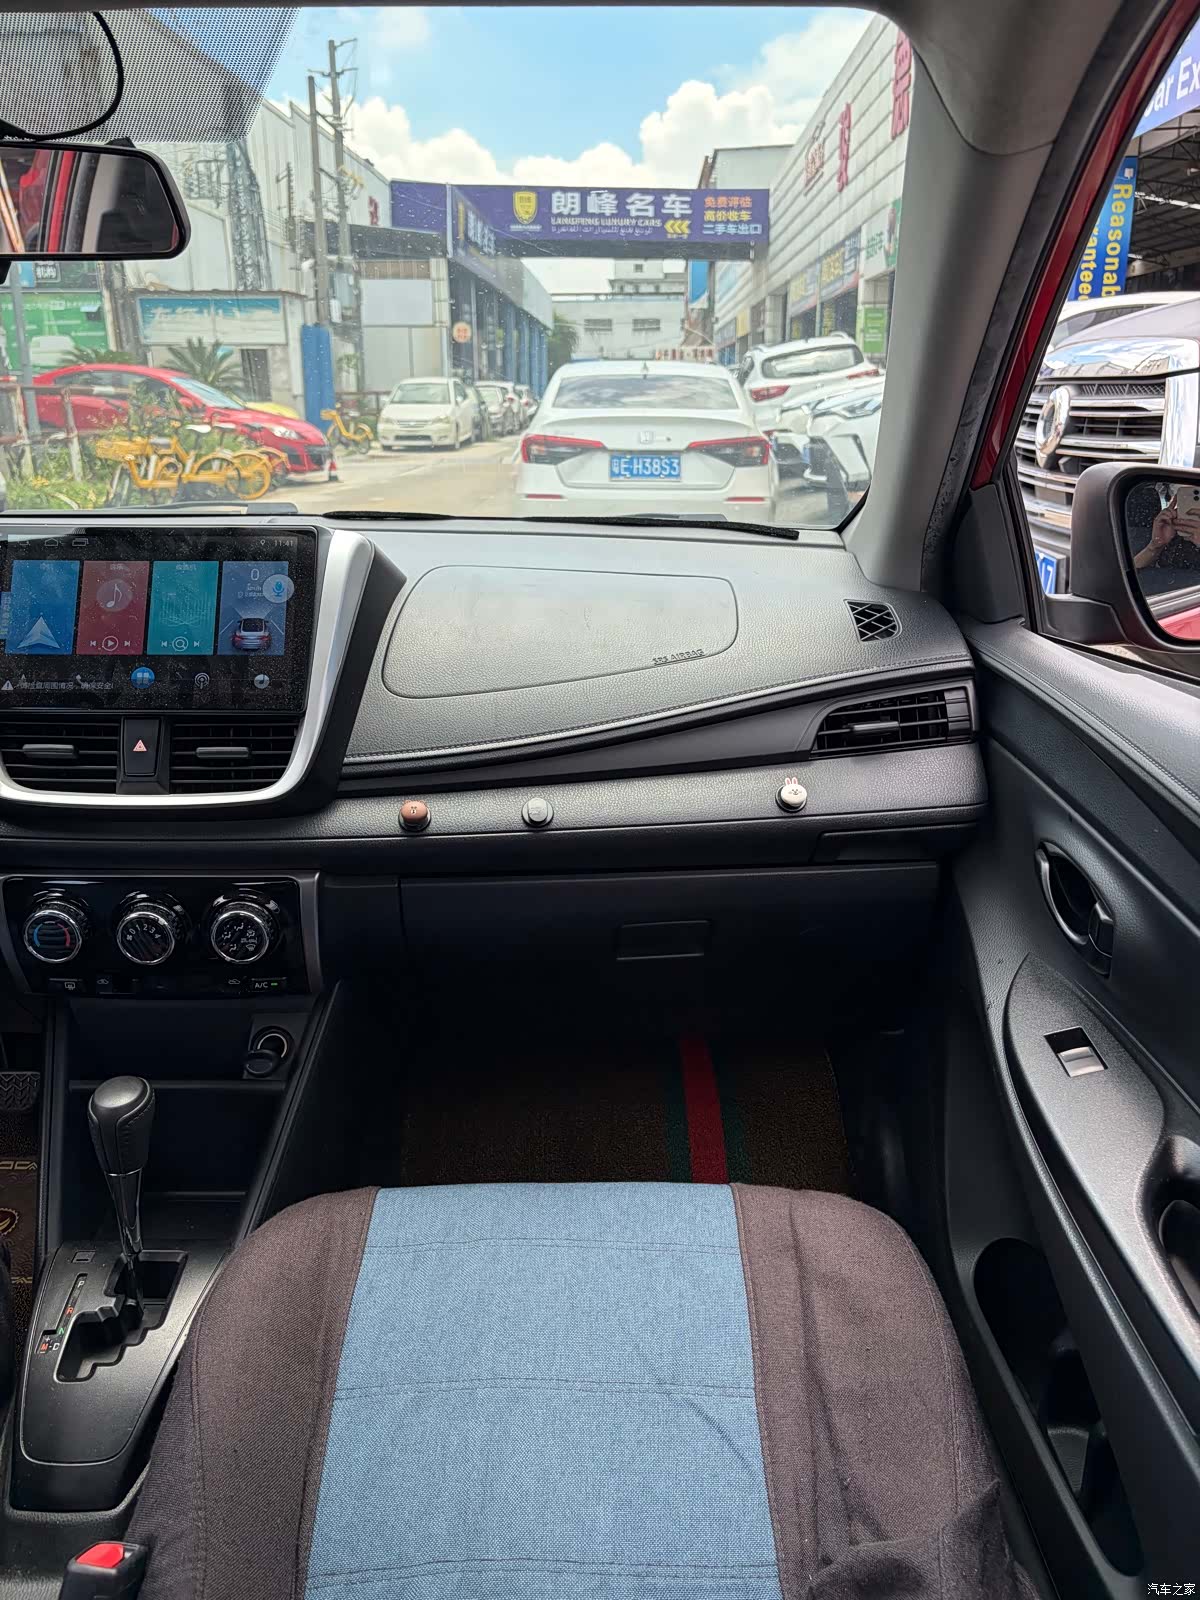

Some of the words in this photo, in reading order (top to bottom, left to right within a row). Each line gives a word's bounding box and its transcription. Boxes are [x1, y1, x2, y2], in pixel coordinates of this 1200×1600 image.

[551, 190, 693, 218] 朗峰名车
[250, 568, 260, 581] 0
[670, 648, 705, 661] AIRBAG
[255, 981, 269, 989] A/C
[77, 1280, 85, 1288] P
